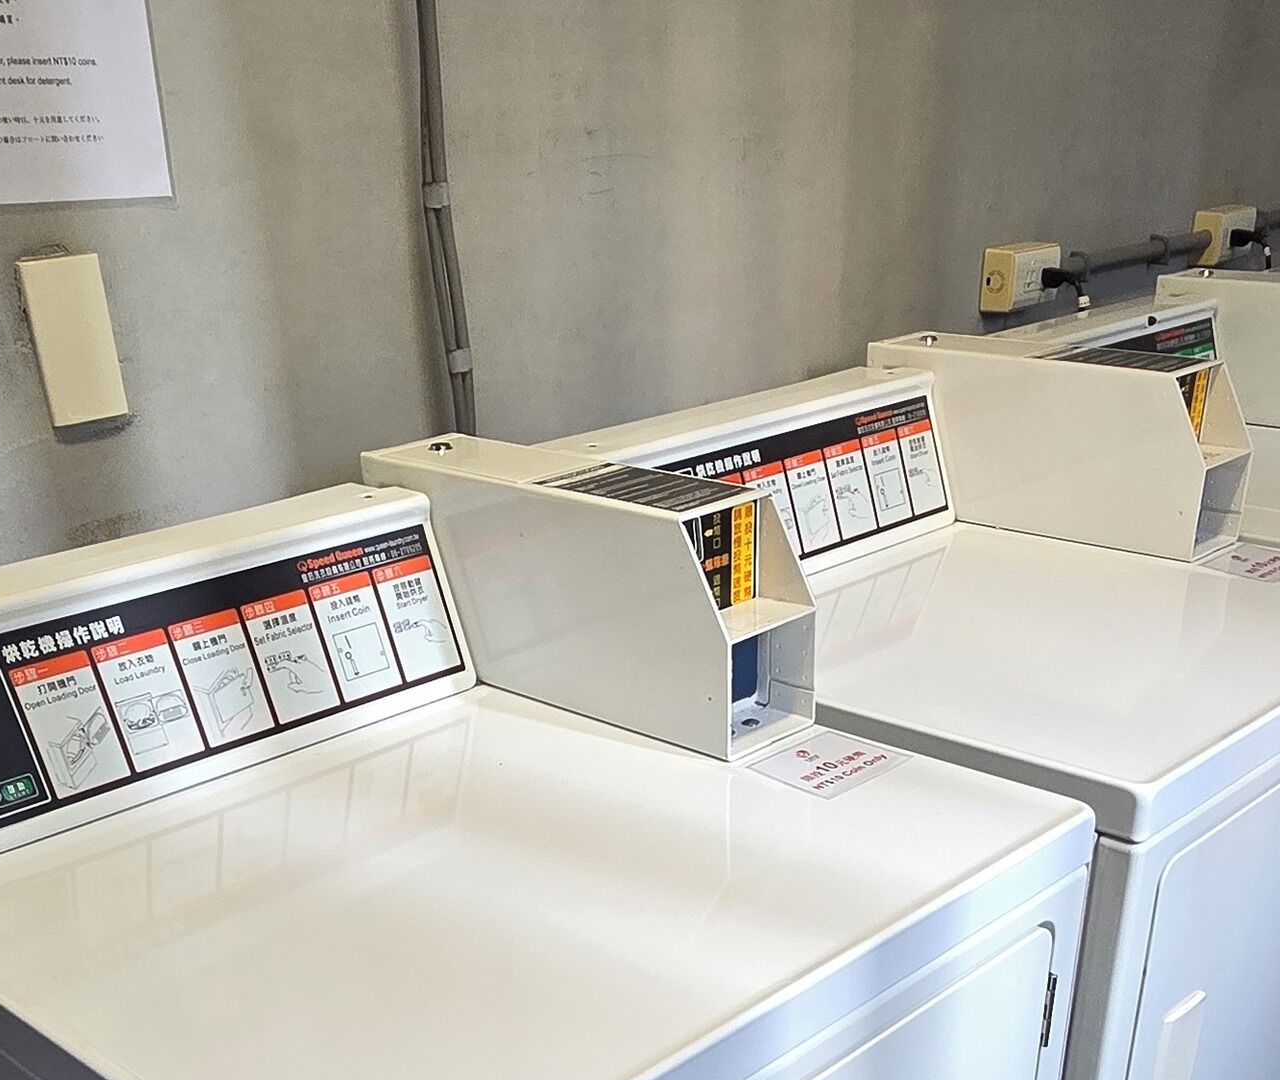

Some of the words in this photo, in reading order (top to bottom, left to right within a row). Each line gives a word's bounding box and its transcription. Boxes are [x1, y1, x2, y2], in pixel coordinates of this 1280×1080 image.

[6, 56, 30, 66] please
[32, 56, 52, 65] insert
[8, 77, 25, 85] desk
[26, 76, 36, 85] for
[307, 552, 336, 569] Speed
[335, 547, 364, 561] Queen
[396, 600, 412, 609] Start
[413, 595, 429, 606] Dryer
[327, 610, 351, 624] Insert
[352, 605, 371, 617] Coin
[1, 615, 126, 664] 烘乾機操作說明
[253, 636, 266, 647] Set
[266, 629, 288, 644] Fabric
[288, 622, 313, 637] Selector
[117, 653, 155, 672] 放入衣物
[182, 655, 202, 666] Close
[202, 647, 230, 662] Loading
[230, 641, 246, 652] Door
[37, 674, 78, 696] 打開機門
[114, 673, 135, 686] Load
[135, 665, 167, 680] Laundry
[24, 696, 47, 712] Open
[47, 688, 77, 704] Loading
[77, 683, 97, 696] Door
[813, 774, 844, 791] NT$10
[842, 765, 865, 777] Coin
[864, 754, 888, 767] Only
